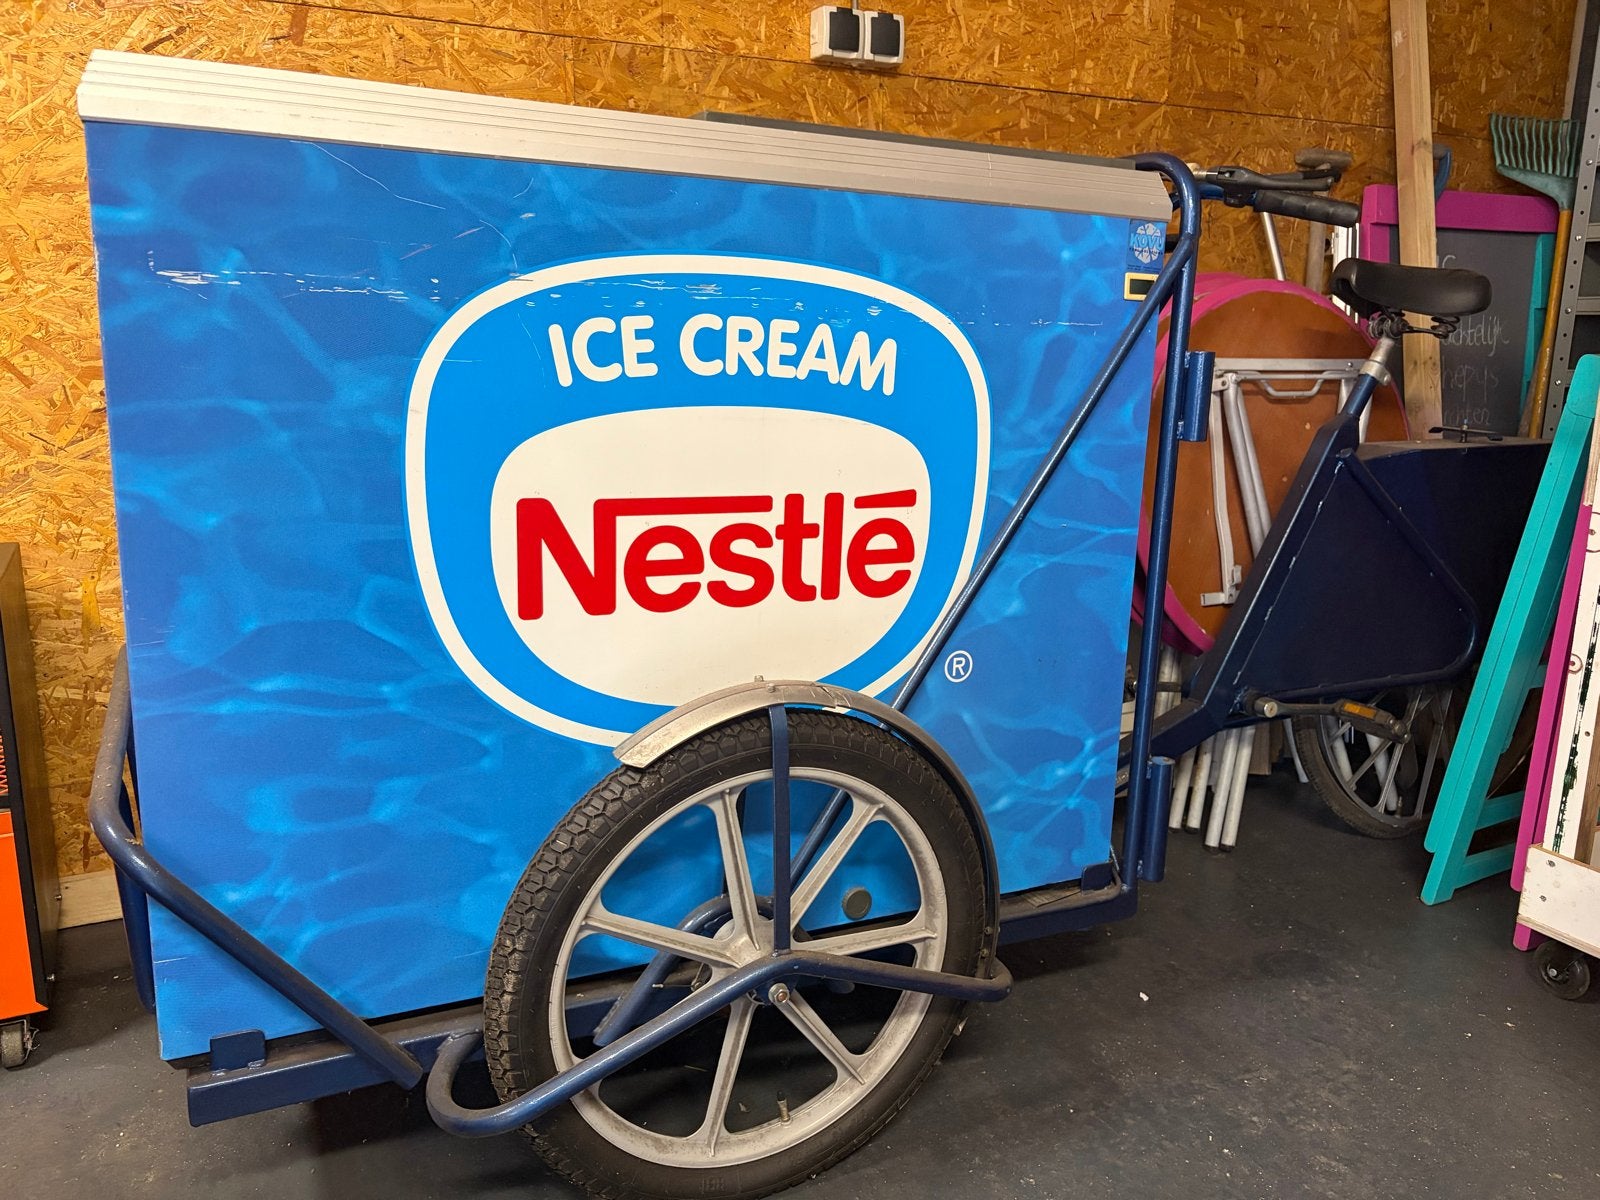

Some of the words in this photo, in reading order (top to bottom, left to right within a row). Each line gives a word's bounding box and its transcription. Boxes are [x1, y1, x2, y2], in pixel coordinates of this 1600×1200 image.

[549, 315, 657, 387] ICE
[678, 313, 897, 396] CREAM
[516, 489, 917, 620] Nestlé
